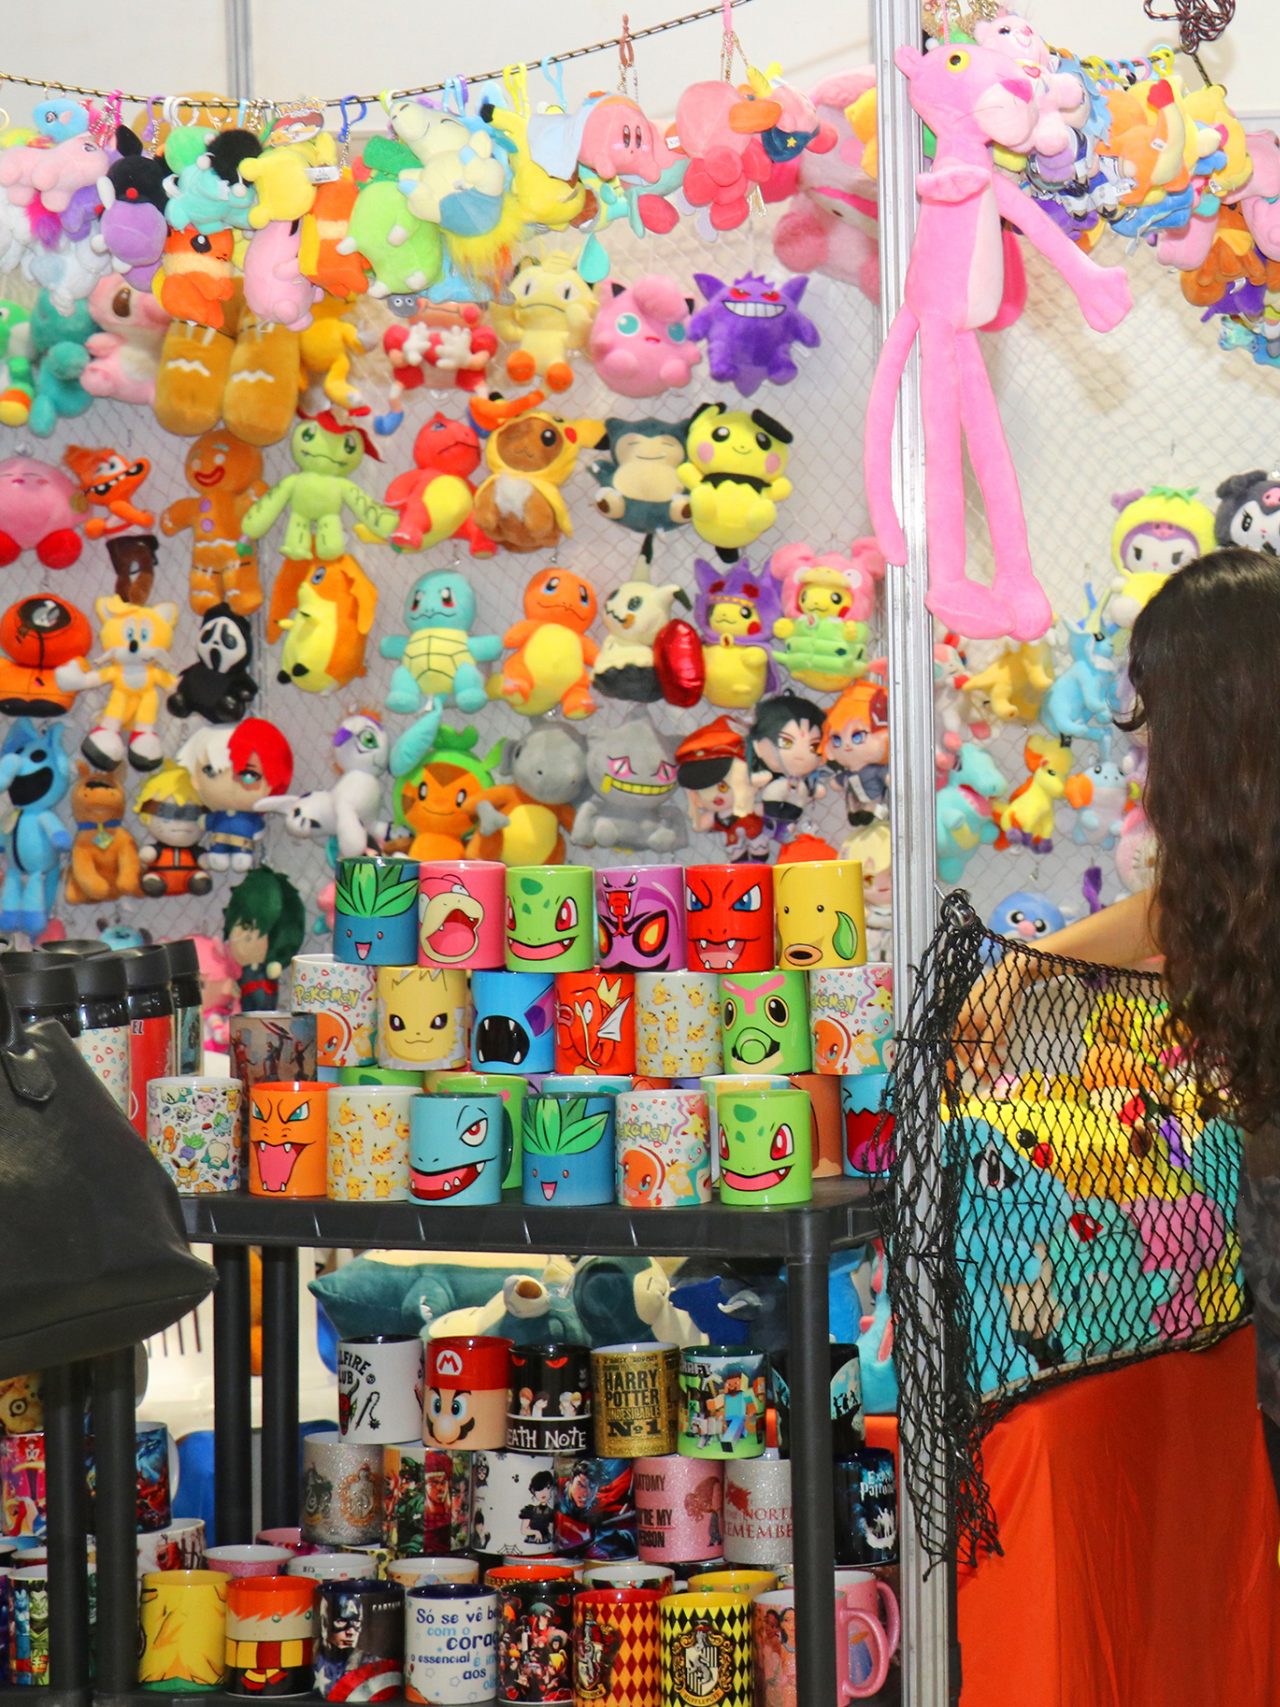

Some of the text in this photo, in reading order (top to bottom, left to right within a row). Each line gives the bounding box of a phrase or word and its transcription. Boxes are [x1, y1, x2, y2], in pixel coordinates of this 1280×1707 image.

[339, 1369, 354, 1385] LUB
[605, 1369, 658, 1391] HARRY
[605, 1389, 660, 1409] POTTER
[507, 1426, 587, 1449] EATH NOTE
[656, 1509, 673, 1526] MY
[742, 1507, 793, 1522] NORT
[726, 1522, 793, 1539] EMEMBE
[416, 1608, 435, 1624] Só
[441, 1613, 459, 1625] se
[466, 1606, 483, 1622] vê
[427, 1626, 471, 1637] com o
[418, 1652, 470, 1664] essencial
[462, 1668, 487, 1680] aos
